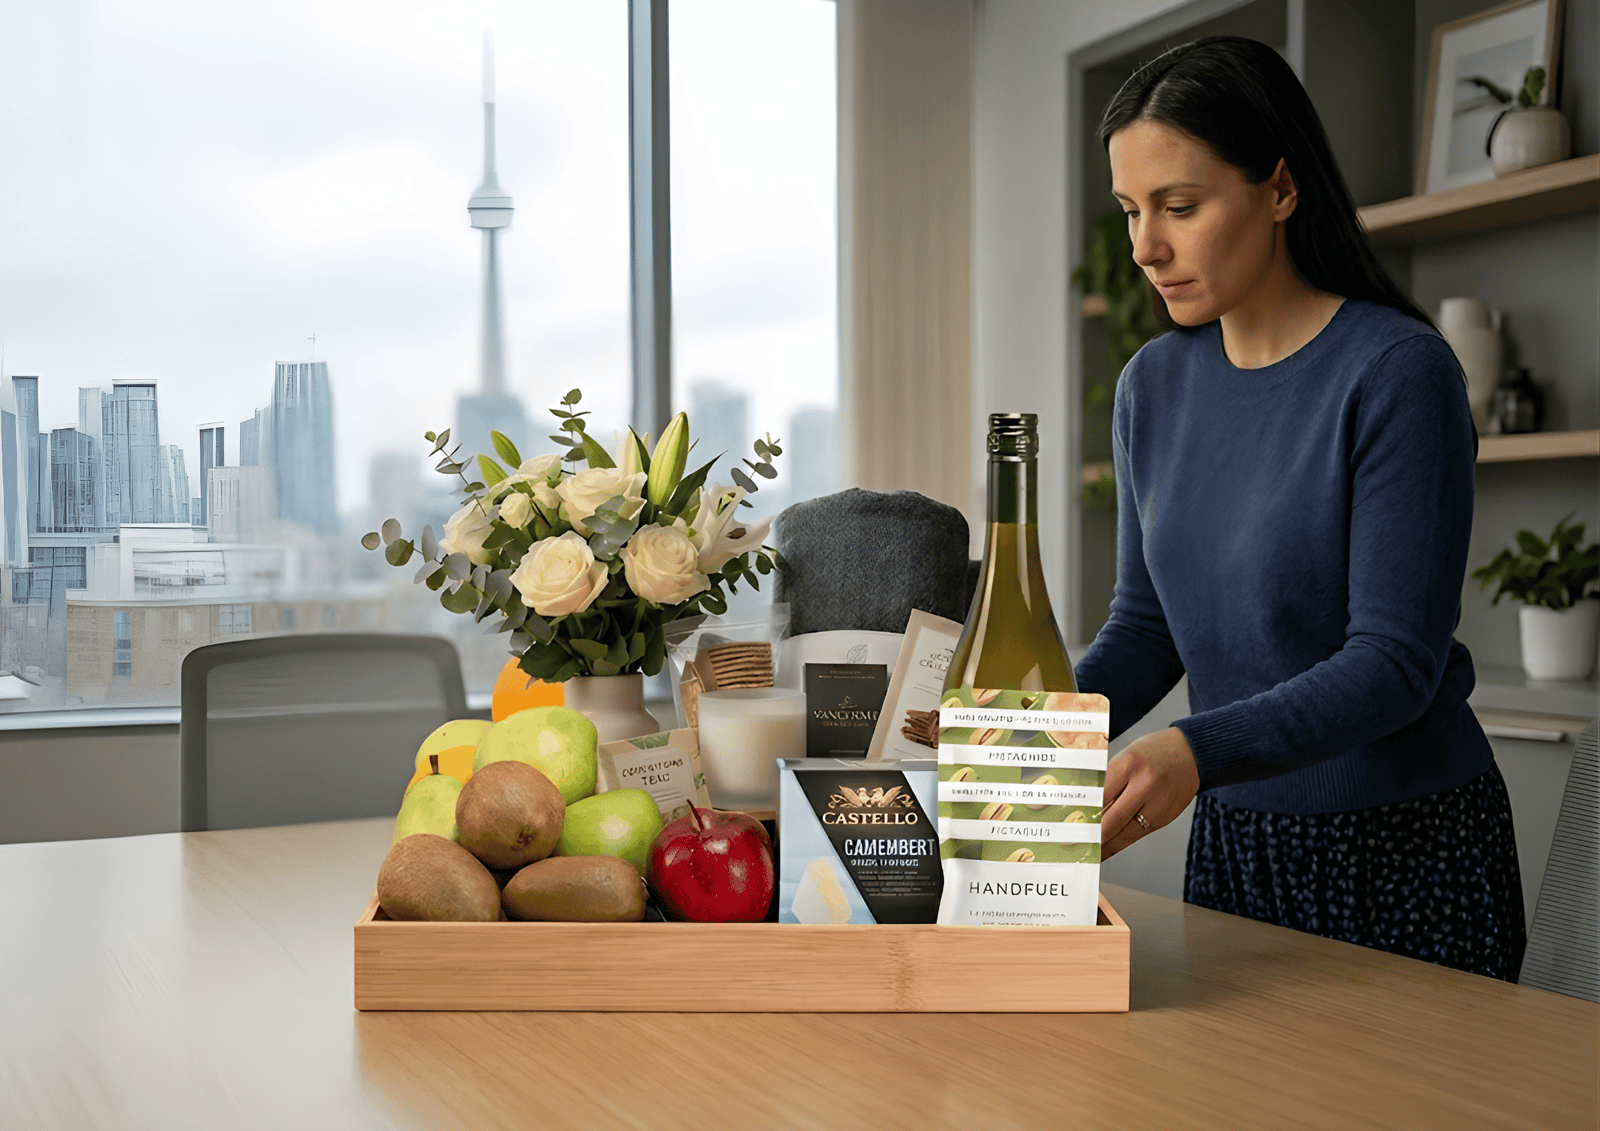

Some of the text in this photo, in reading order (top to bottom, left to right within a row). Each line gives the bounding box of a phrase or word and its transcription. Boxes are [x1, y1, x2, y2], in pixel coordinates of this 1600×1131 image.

[822, 812, 918, 825] CASTELLO
[844, 838, 935, 856] CAMEMBERT
[969, 881, 1069, 897] HANDFUEL
